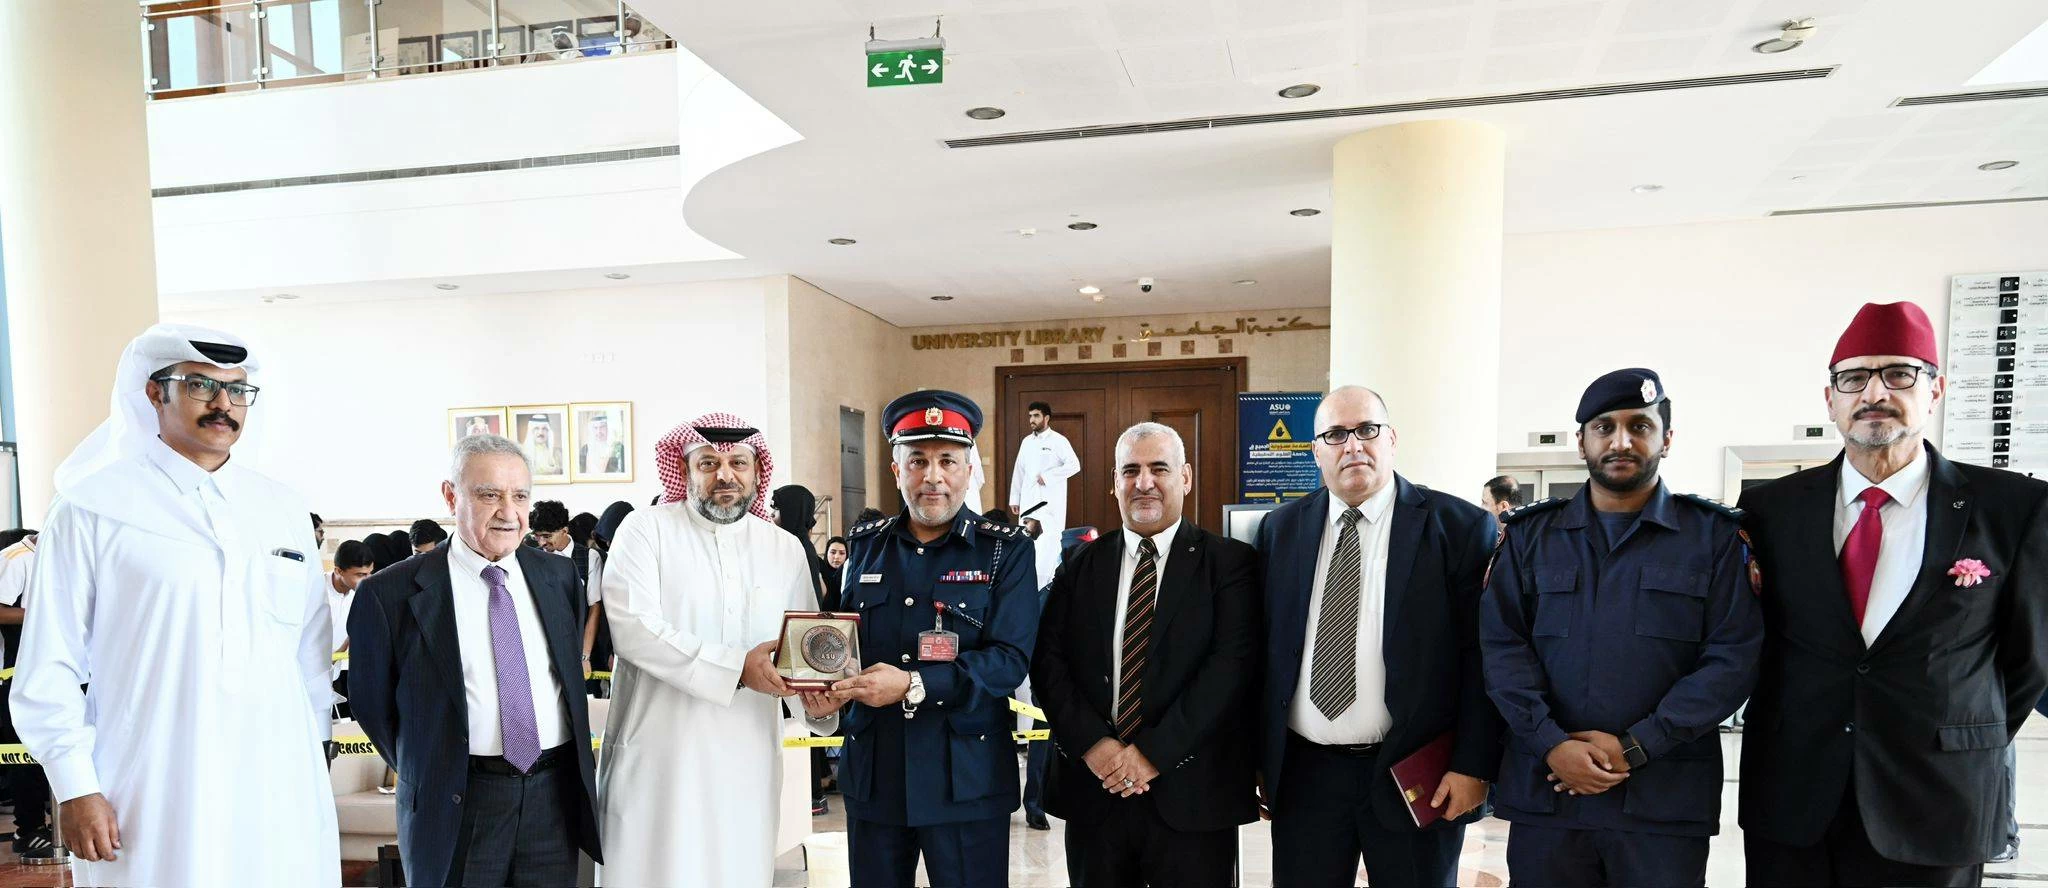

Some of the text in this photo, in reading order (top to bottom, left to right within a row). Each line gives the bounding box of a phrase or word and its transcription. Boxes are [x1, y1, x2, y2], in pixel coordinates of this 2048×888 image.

[1140, 318, 1246, 340] الجامعة
[911, 326, 1106, 350] UNIVERSITY LIBRARY
[338, 742, 374, 754] CROSS
[1, 752, 22, 764] NOT
